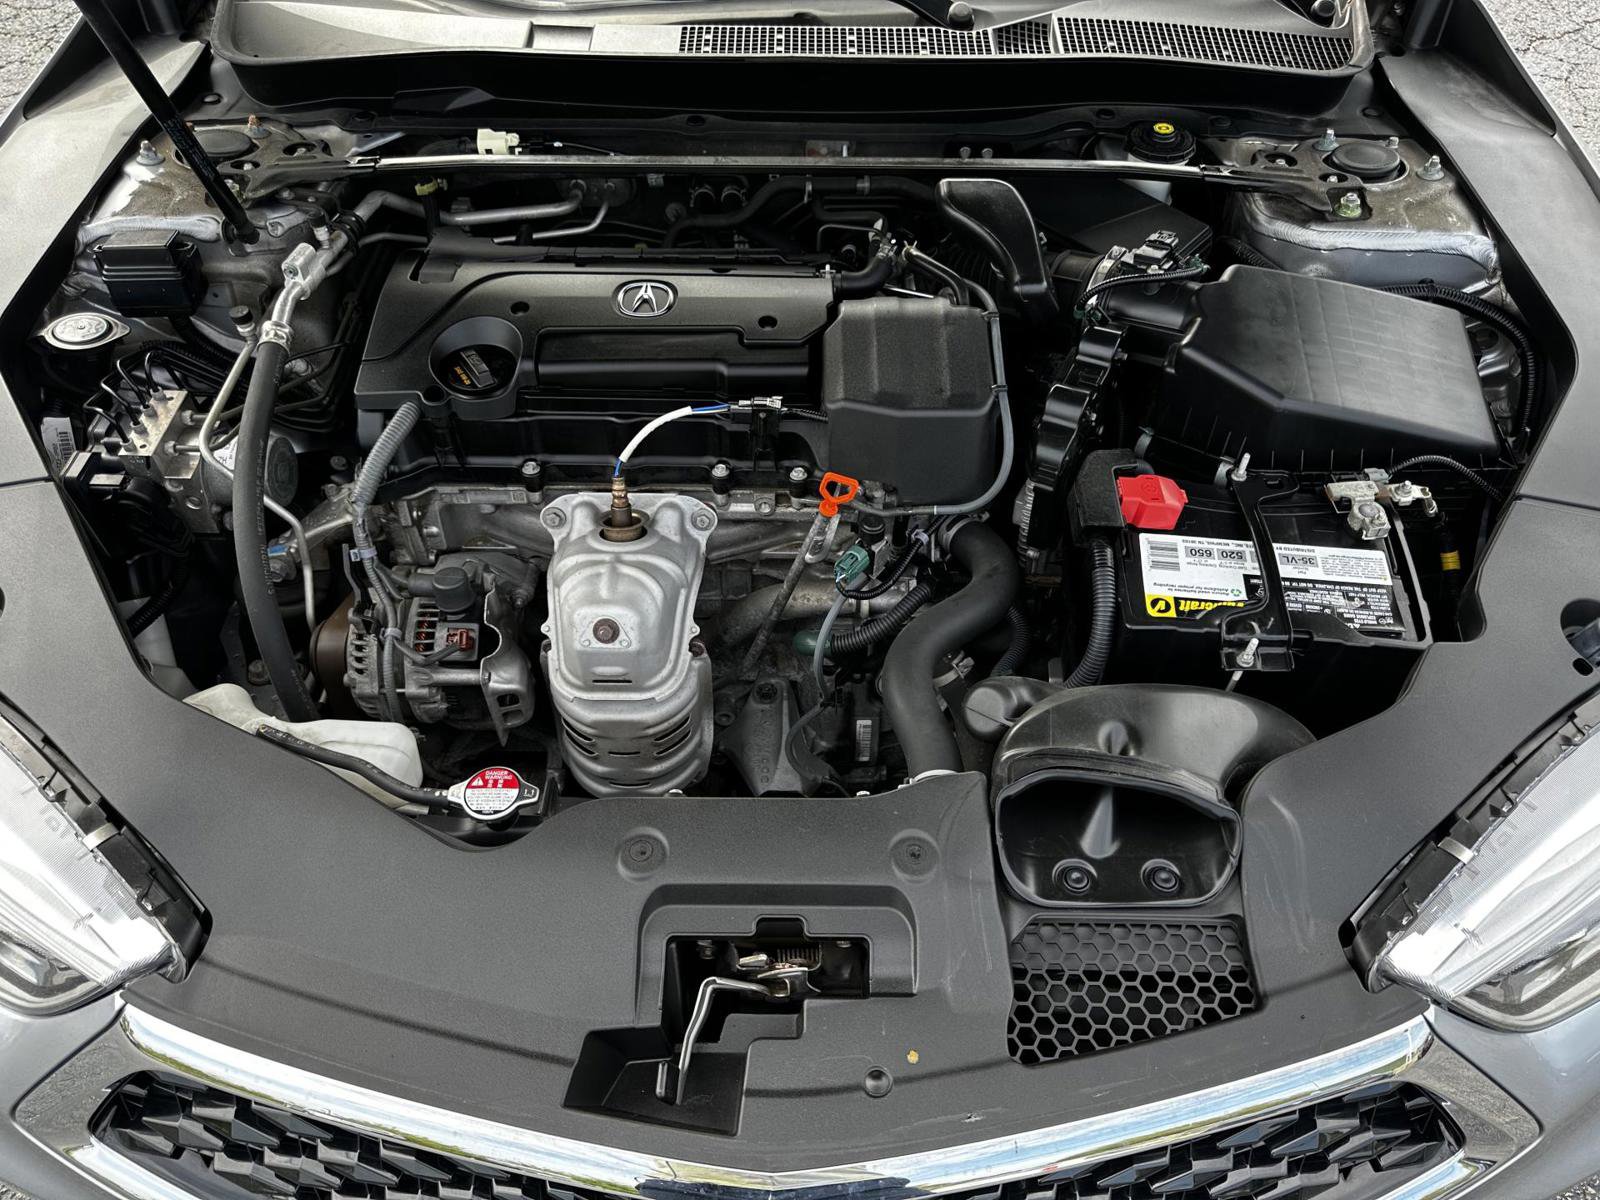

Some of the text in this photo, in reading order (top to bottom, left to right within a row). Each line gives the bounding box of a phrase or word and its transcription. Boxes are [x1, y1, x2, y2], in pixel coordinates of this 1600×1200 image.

[1190, 548, 1212, 557] 650
[1221, 550, 1243, 559] 520
[1282, 555, 1315, 564] 35-VL
